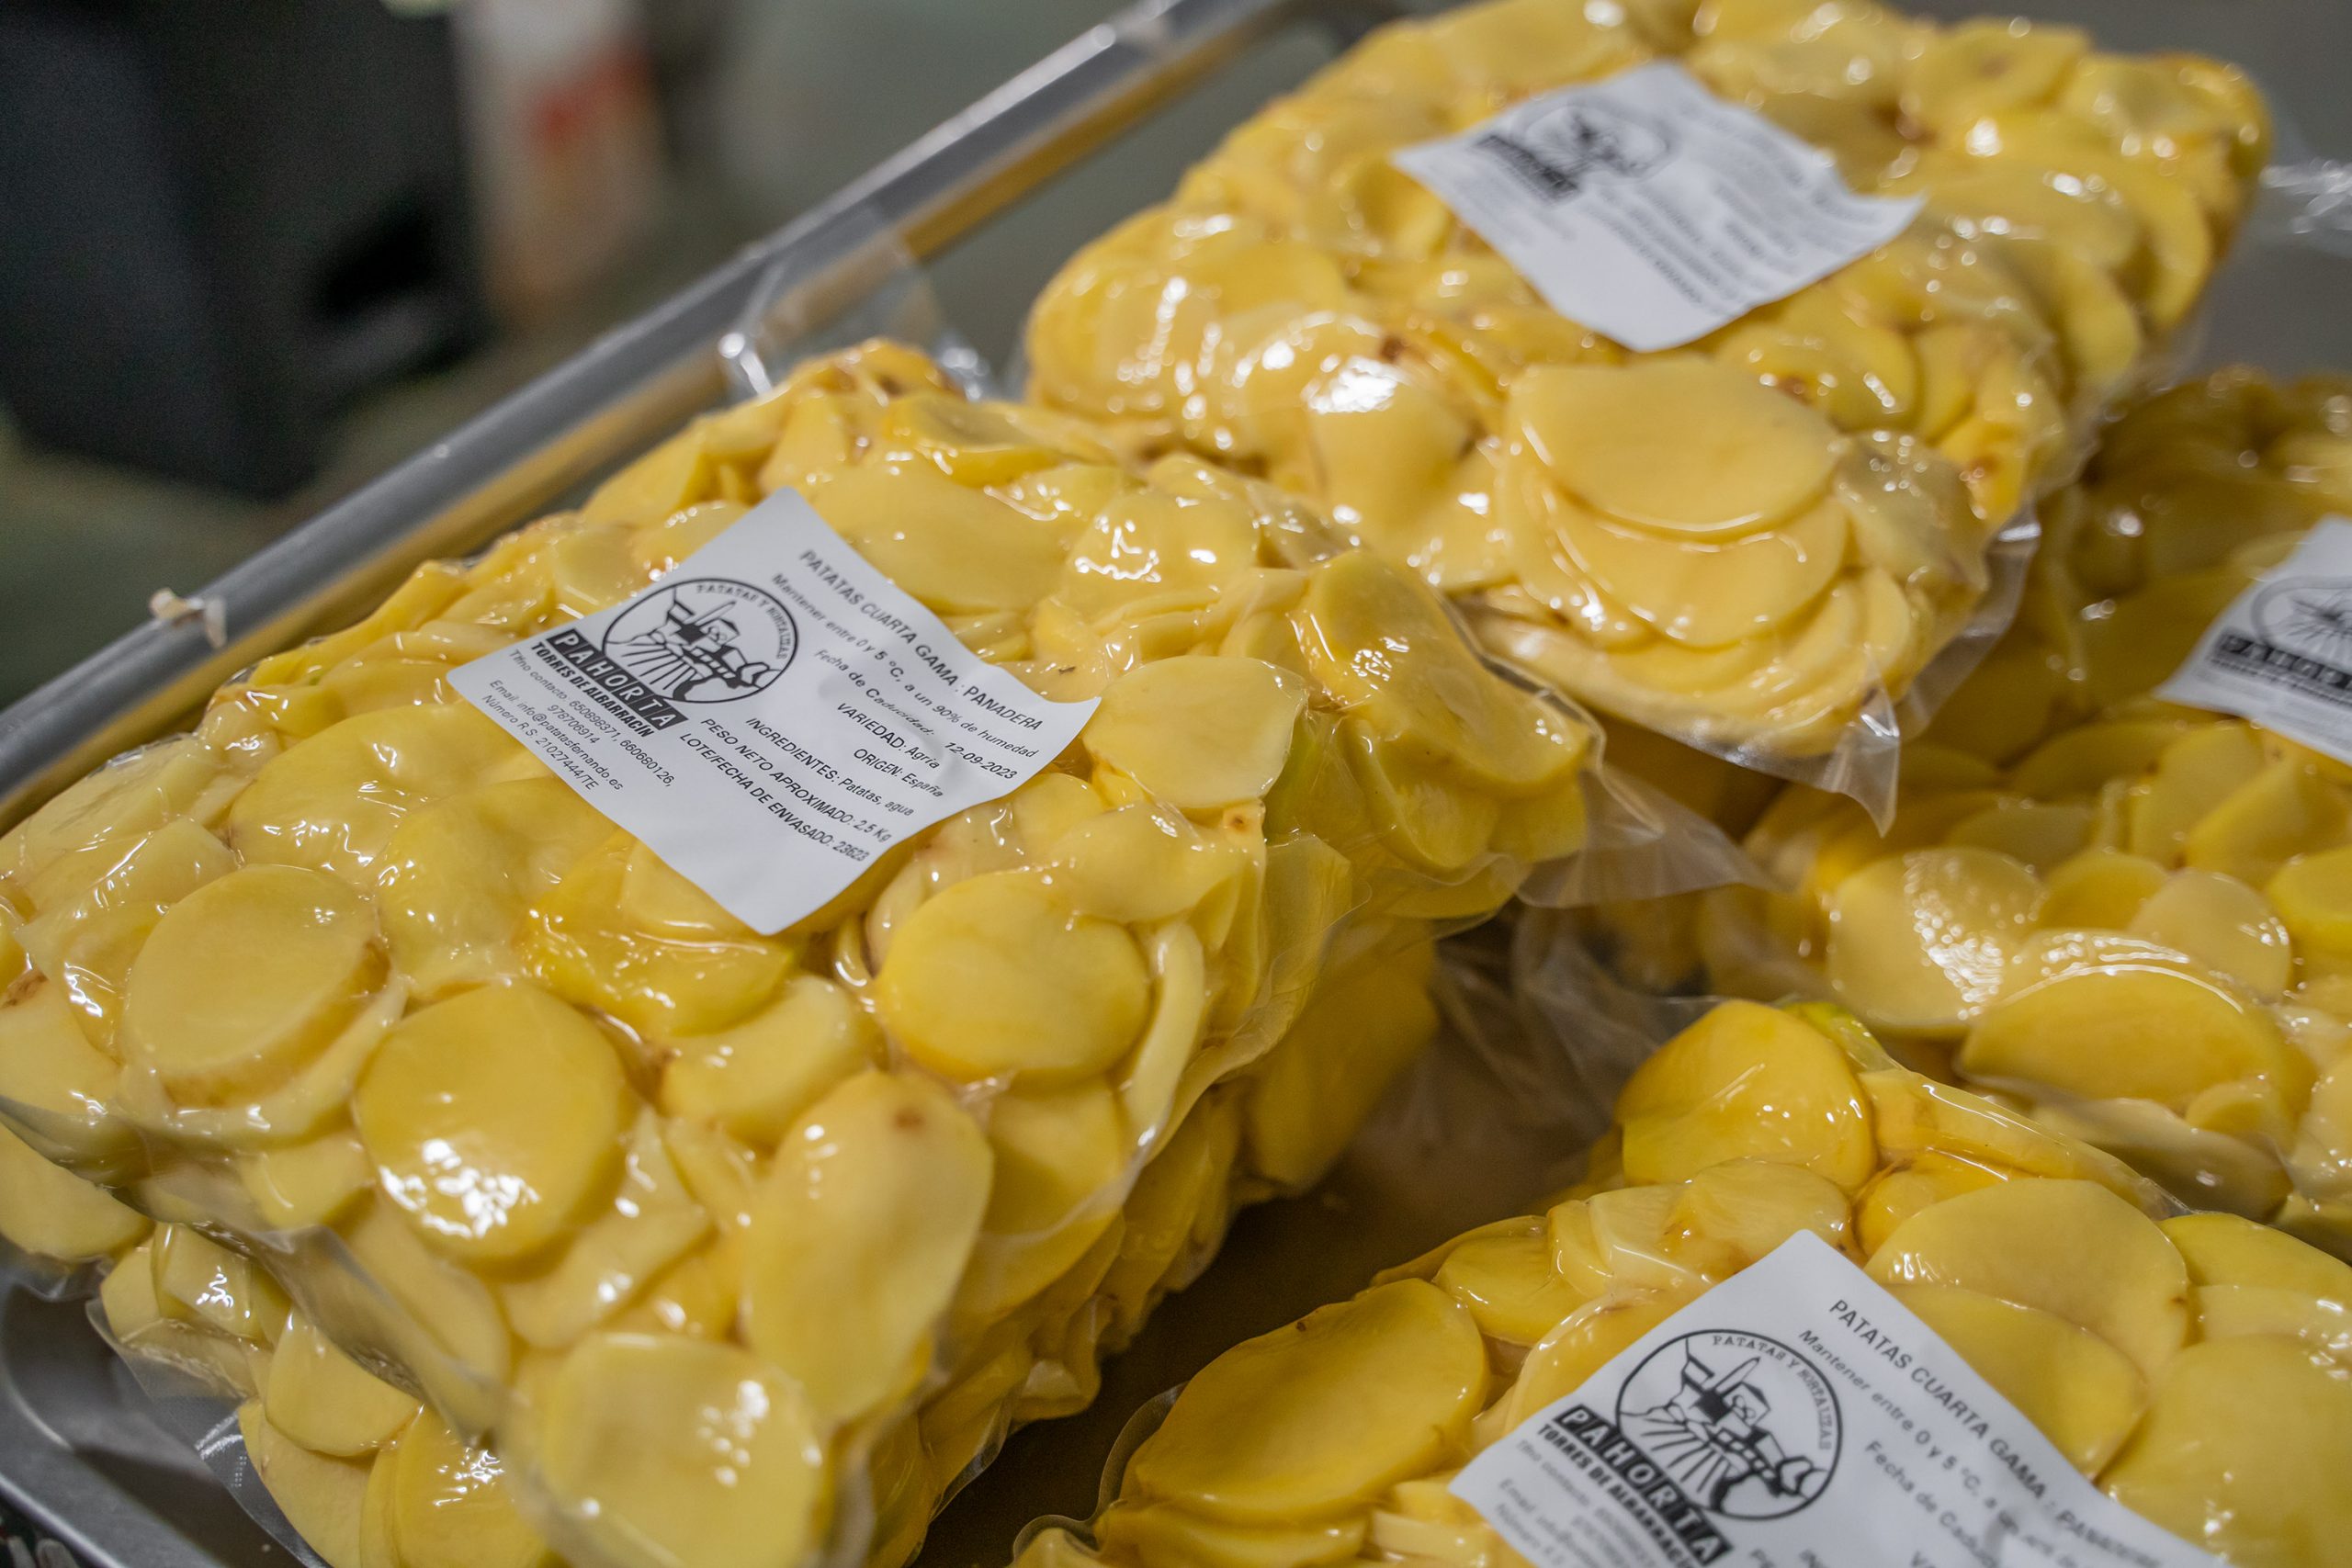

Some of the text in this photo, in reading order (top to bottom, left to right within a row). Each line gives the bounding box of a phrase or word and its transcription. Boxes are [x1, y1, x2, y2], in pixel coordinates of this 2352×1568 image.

[554, 634, 676, 727] PAHORTA
[772, 572, 826, 621] Mantener
[826, 621, 856, 642] entre
[856, 638, 868, 648] 0
[875, 650, 888, 660] 5
[914, 693, 933, 706] un
[933, 705, 963, 723] 90%
[960, 721, 978, 733] de
[978, 729, 1039, 758] humedad
[799, 549, 865, 605] PATATAS
[860, 603, 917, 644] CUARTA
[915, 645, 958, 686] GAMA
[963, 685, 1043, 730] PANADERA
[531, 641, 655, 738] TORRES DE ALBARRACÍN
[548, 705, 600, 745] 978706914
[814, 649, 1017, 779] Fecha de Caducidad: 12-09-2023
[837, 703, 940, 769] VARIEDAD: Agria
[481, 694, 518, 724] Número
[535, 737, 600, 790] 21027444/TE
[516, 701, 624, 791] info@patatasfernando.es
[619, 739, 675, 787] 660680126,
[679, 733, 754, 790] LOTE/FECHA
[749, 787, 774, 804] DE
[767, 802, 835, 847] ENVASADO:
[700, 718, 892, 843] PESO NETO APROXIMADO: 2,5 Kg
[745, 717, 914, 817] INGREDIENTES: Patatas, agua
[853, 749, 944, 797] ORIGEN: España
[1713, 1336, 1787, 1360] PATATAS
[1787, 1359, 1801, 1369] Y
[1798, 1329, 1871, 1391] Mantener
[1871, 1387, 1915, 1434] entre
[1915, 1428, 1931, 1445] 0
[1926, 1445, 1943, 1460] y
[1828, 1299, 1914, 1371] PATATAS
[1911, 1367, 1991, 1441] CUARTA
[1989, 1438, 2048, 1500] GAMA
[1537, 1424, 1593, 1470] TORRES
[1563, 1410, 1722, 1562] PAHORTA
[1864, 1439, 1915, 1493] Fecha
[1916, 1492, 1938, 1513] de
